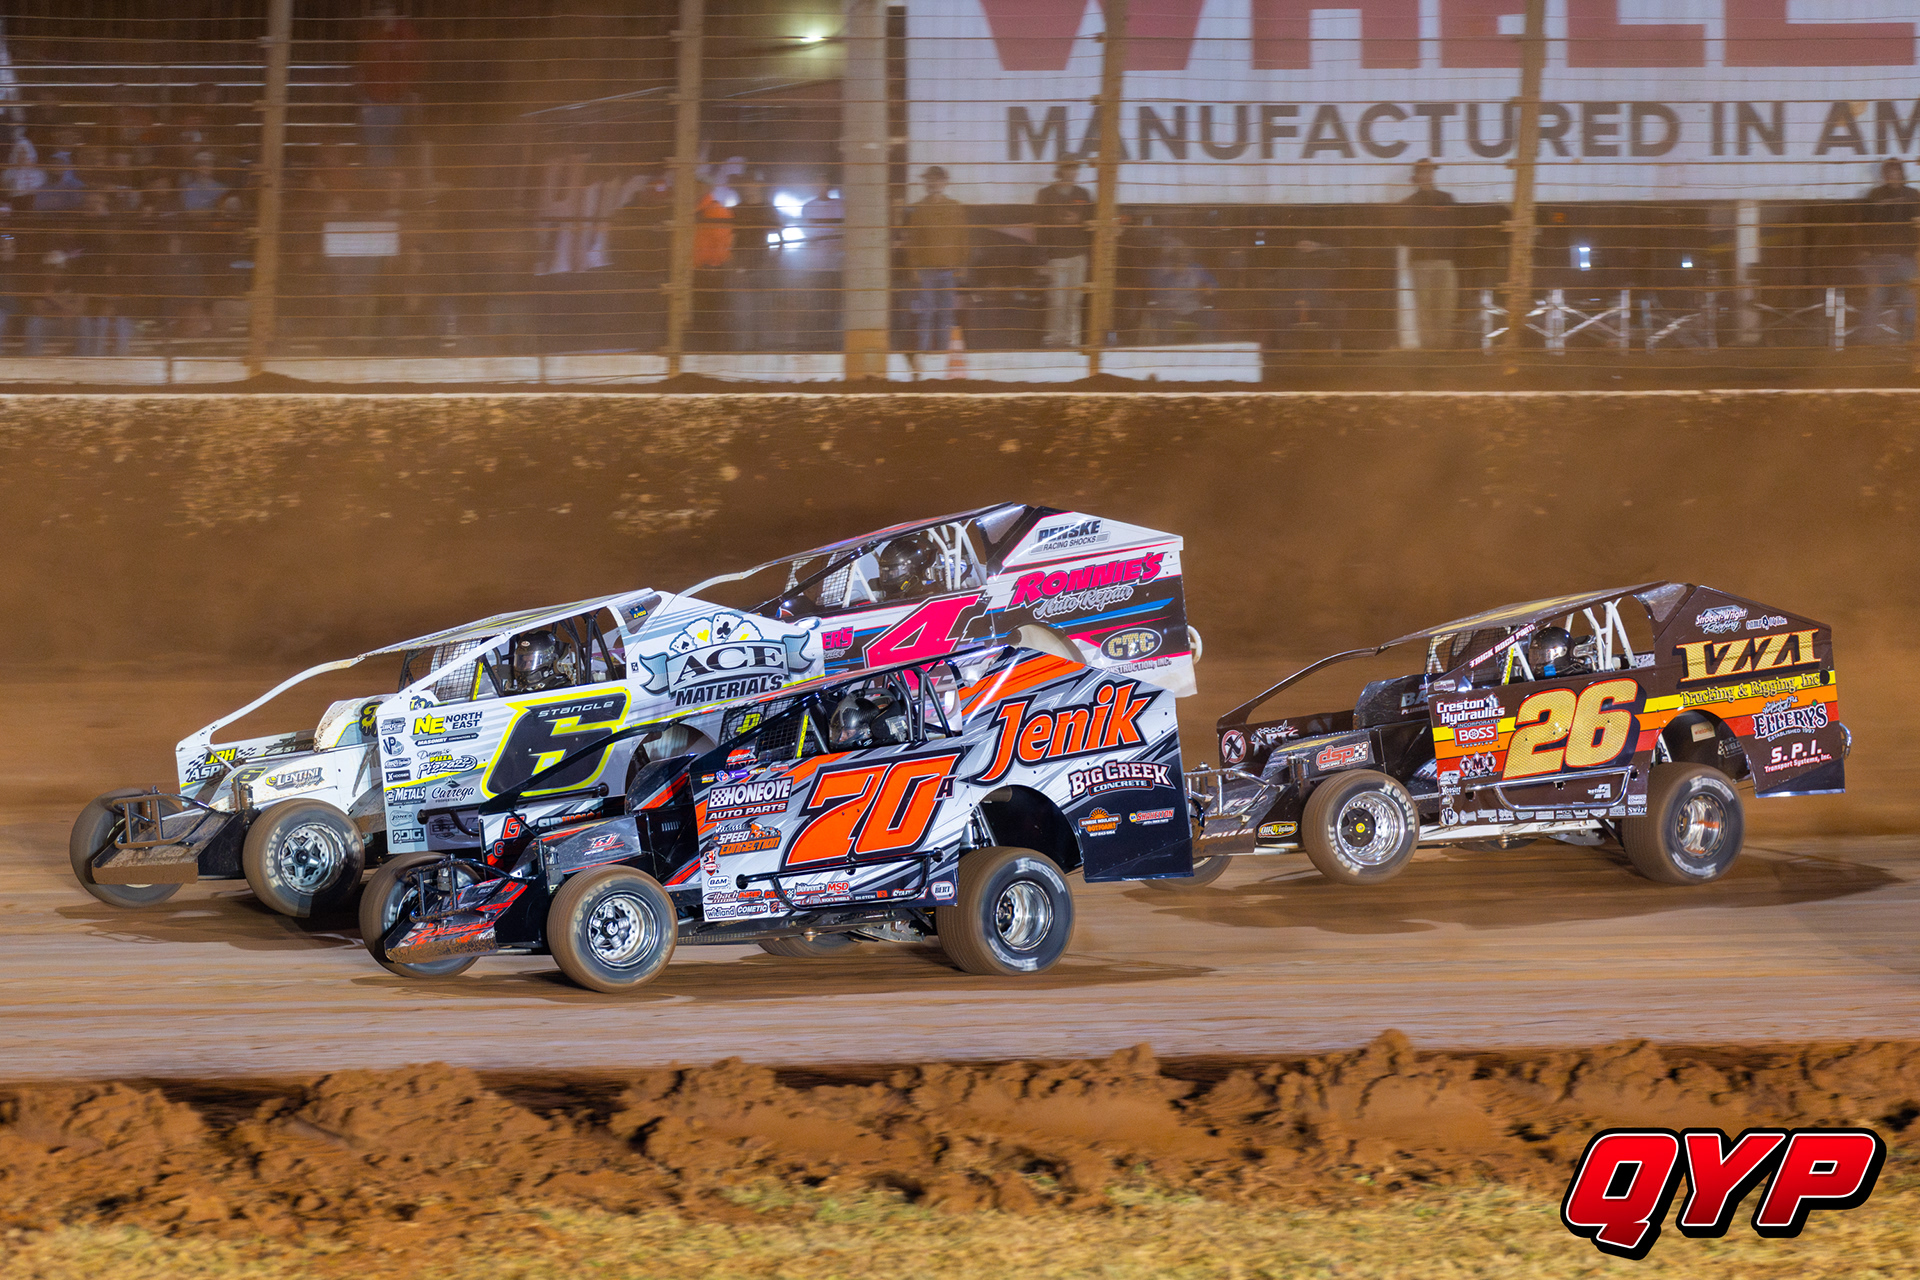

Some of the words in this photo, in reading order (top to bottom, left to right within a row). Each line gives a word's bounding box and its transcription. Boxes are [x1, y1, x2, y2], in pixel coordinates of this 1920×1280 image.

[1708, 101, 1784, 156] IN
[1038, 520, 1101, 543] PENSKE
[1043, 540, 1068, 551] RACING
[1069, 536, 1097, 547] SHOCKS
[1010, 552, 1165, 606] RONNIE'S
[1034, 597, 1078, 619] Auto
[1080, 586, 1133, 611] Repair
[866, 594, 981, 691] 4
[1107, 632, 1155, 658] CTC
[672, 645, 785, 686] ACE
[1675, 628, 1822, 683] IZZI
[1103, 660, 1155, 675] ONSTRUCTION,
[675, 676, 783, 706] MATERIALS
[1679, 685, 1736, 705] Trucking
[1737, 682, 1748, 697] &
[1436, 699, 1485, 714] Creston
[1441, 707, 1505, 725] Hydraulics
[413, 714, 447, 736] NE
[445, 711, 483, 723] NORTH
[452, 719, 480, 730] EAST
[975, 682, 1153, 783] Jenik
[1458, 726, 1495, 742] BOSS
[1502, 678, 1639, 781] 26
[1767, 728, 1801, 742] ESTABLISHED
[417, 737, 447, 746] MASONRY
[429, 755, 453, 763] PIZZA
[1318, 748, 1355, 765] dsp
[1764, 760, 1793, 773] Transport
[1820, 753, 1832, 761] Inc.
[276, 767, 322, 787] LENTINI
[1069, 767, 1104, 797] BIG
[1103, 761, 1172, 786] CREEK
[1093, 779, 1148, 793] CONCRETE
[394, 785, 426, 801] METALS
[431, 786, 475, 802] Carrega
[728, 778, 792, 805] HONEOYE
[708, 808, 743, 820] AUTO
[745, 802, 787, 815] PARTS
[785, 753, 961, 867] 70
[717, 830, 751, 845] SPEED
[719, 836, 781, 856] CONNECTION
[827, 881, 849, 892] MSD
[737, 903, 767, 914] COMETIC
